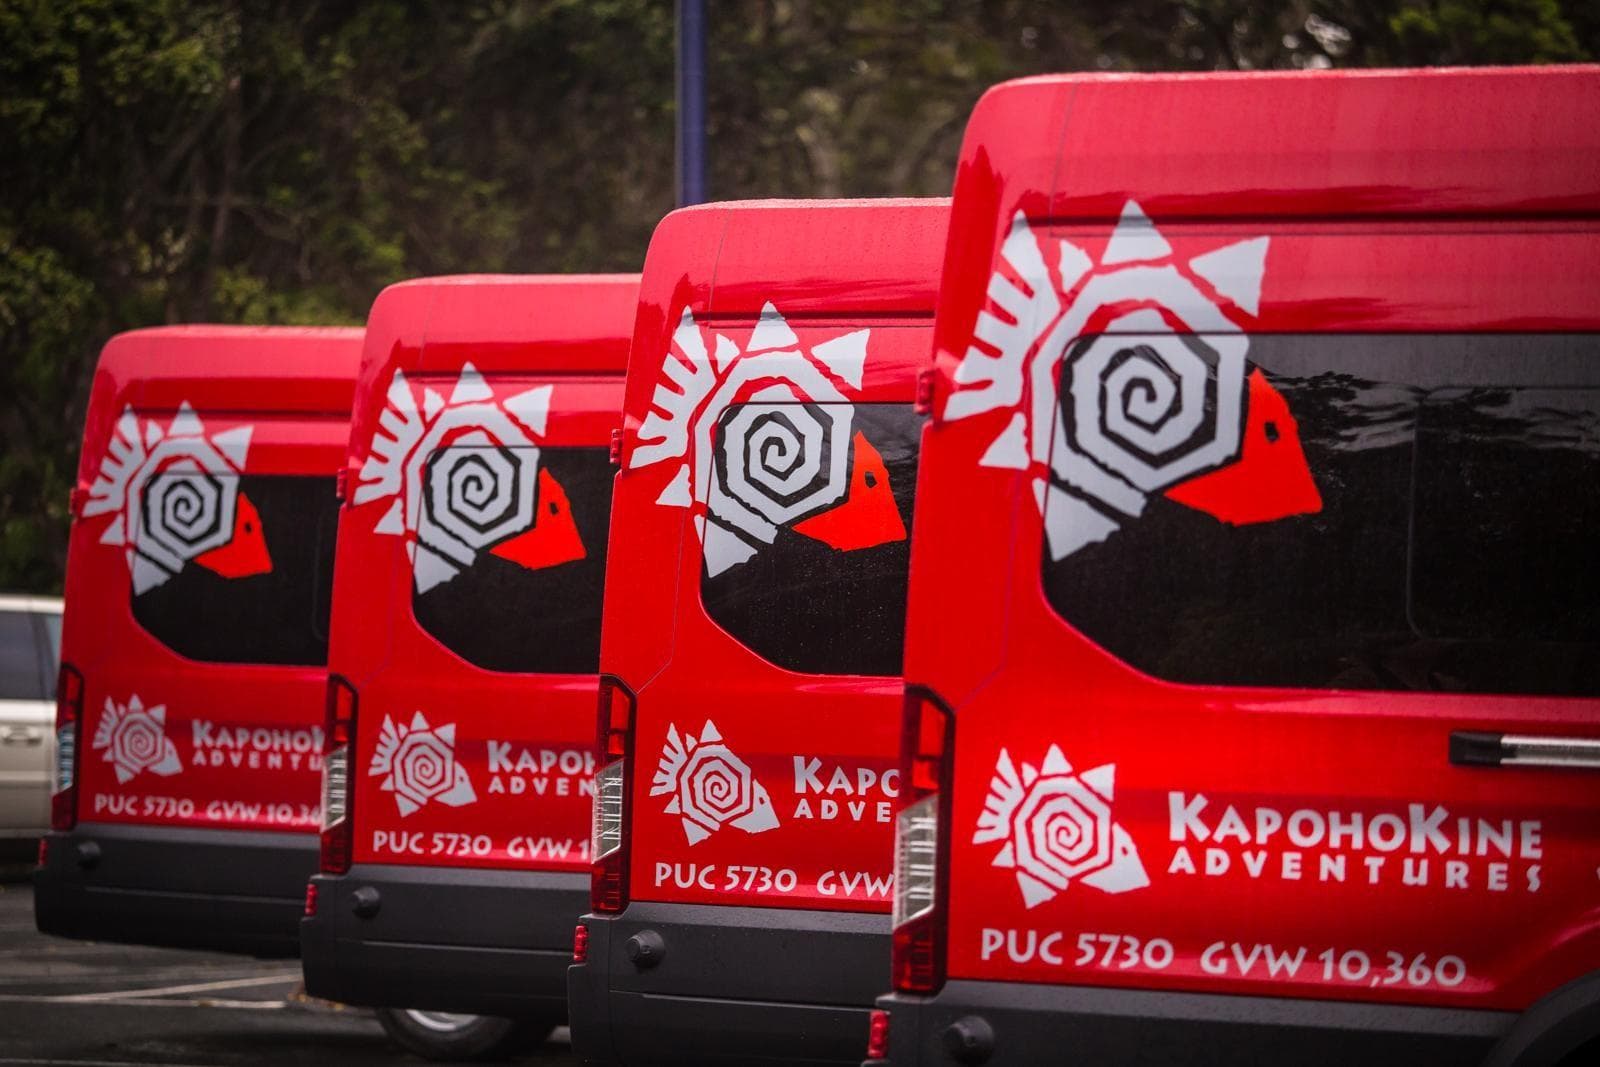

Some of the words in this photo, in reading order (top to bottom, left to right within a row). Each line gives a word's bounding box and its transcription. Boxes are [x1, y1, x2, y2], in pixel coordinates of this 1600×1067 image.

[95, 793, 138, 816] PUC
[143, 795, 195, 818] 5730
[206, 800, 262, 821] GVW
[793, 798, 892, 823] ADVE
[1168, 791, 1543, 859] KAPOHOKINE
[373, 830, 424, 854] PUC
[431, 832, 492, 857] 5730
[507, 837, 572, 860] GVW
[655, 862, 716, 890] PUC
[724, 865, 798, 892] 5730
[816, 870, 895, 898] GVW
[1168, 848, 1542, 893] ADVENTURES
[981, 928, 1063, 966] PUC
[1075, 933, 1175, 970] 5730
[1200, 941, 1308, 977] GVW
[1318, 947, 1467, 989] 10,360
